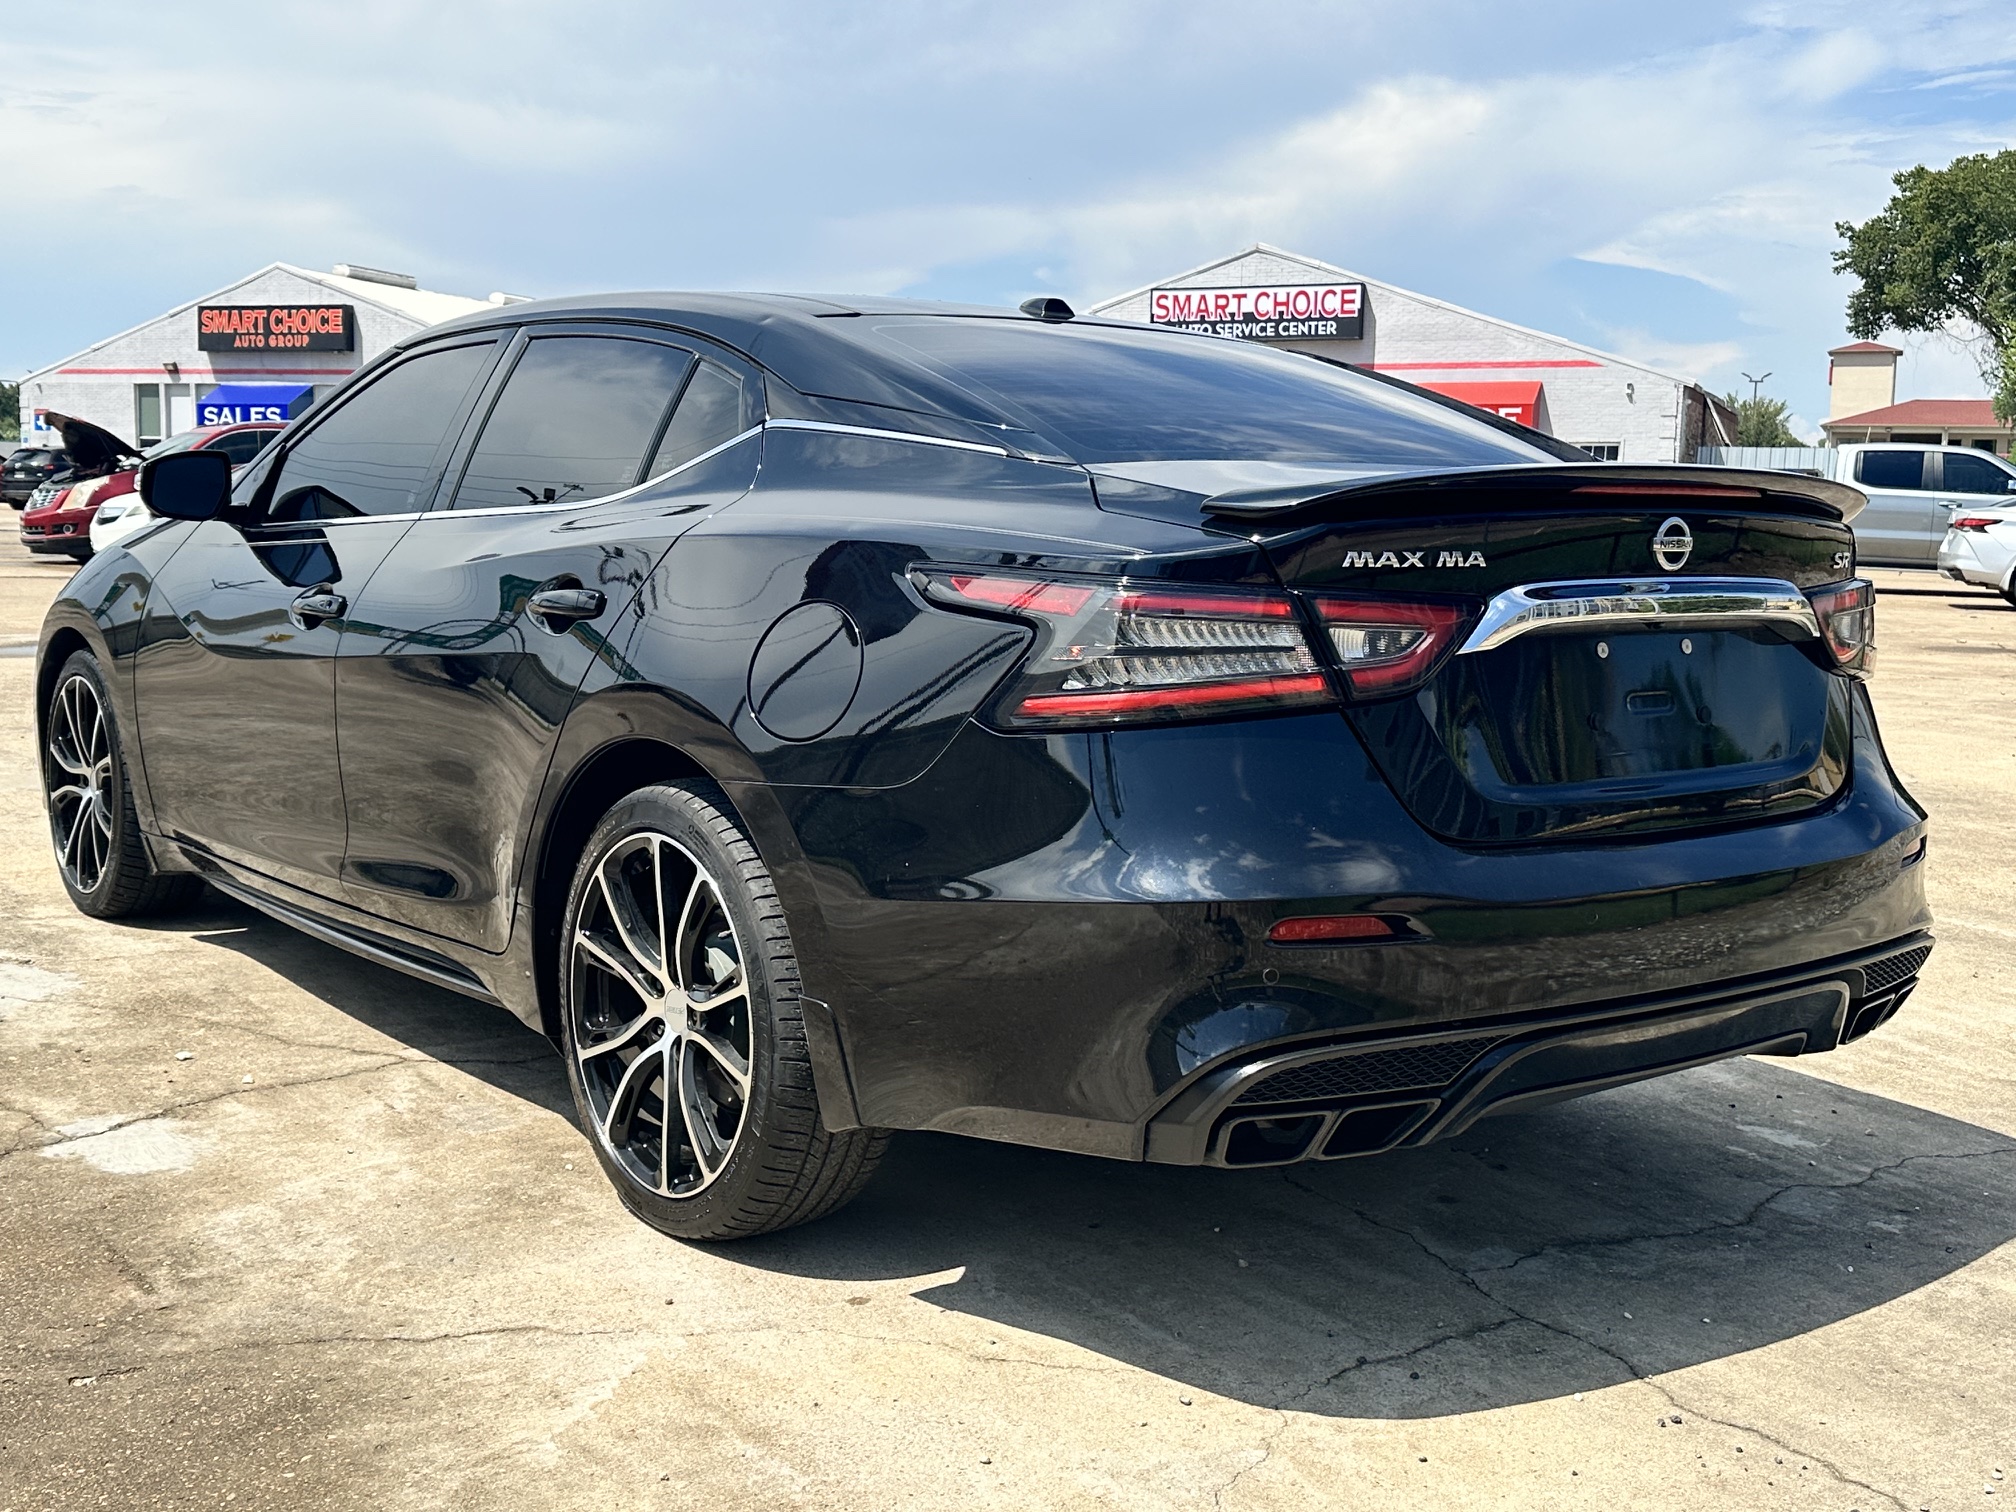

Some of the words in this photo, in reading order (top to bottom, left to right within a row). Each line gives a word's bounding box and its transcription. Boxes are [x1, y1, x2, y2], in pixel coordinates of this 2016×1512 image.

[1154, 293, 1247, 322] SMART
[1253, 290, 1359, 318] CHOICE
[201, 310, 267, 333] SMART
[269, 309, 343, 333] CHOICE
[1215, 321, 1275, 339] SERVICE
[1278, 321, 1337, 336] CENTER
[234, 335, 264, 347] AUTO
[268, 335, 310, 347] GROUP
[1660, 539, 1692, 549] NISSAN
[1833, 552, 1850, 569] SR
